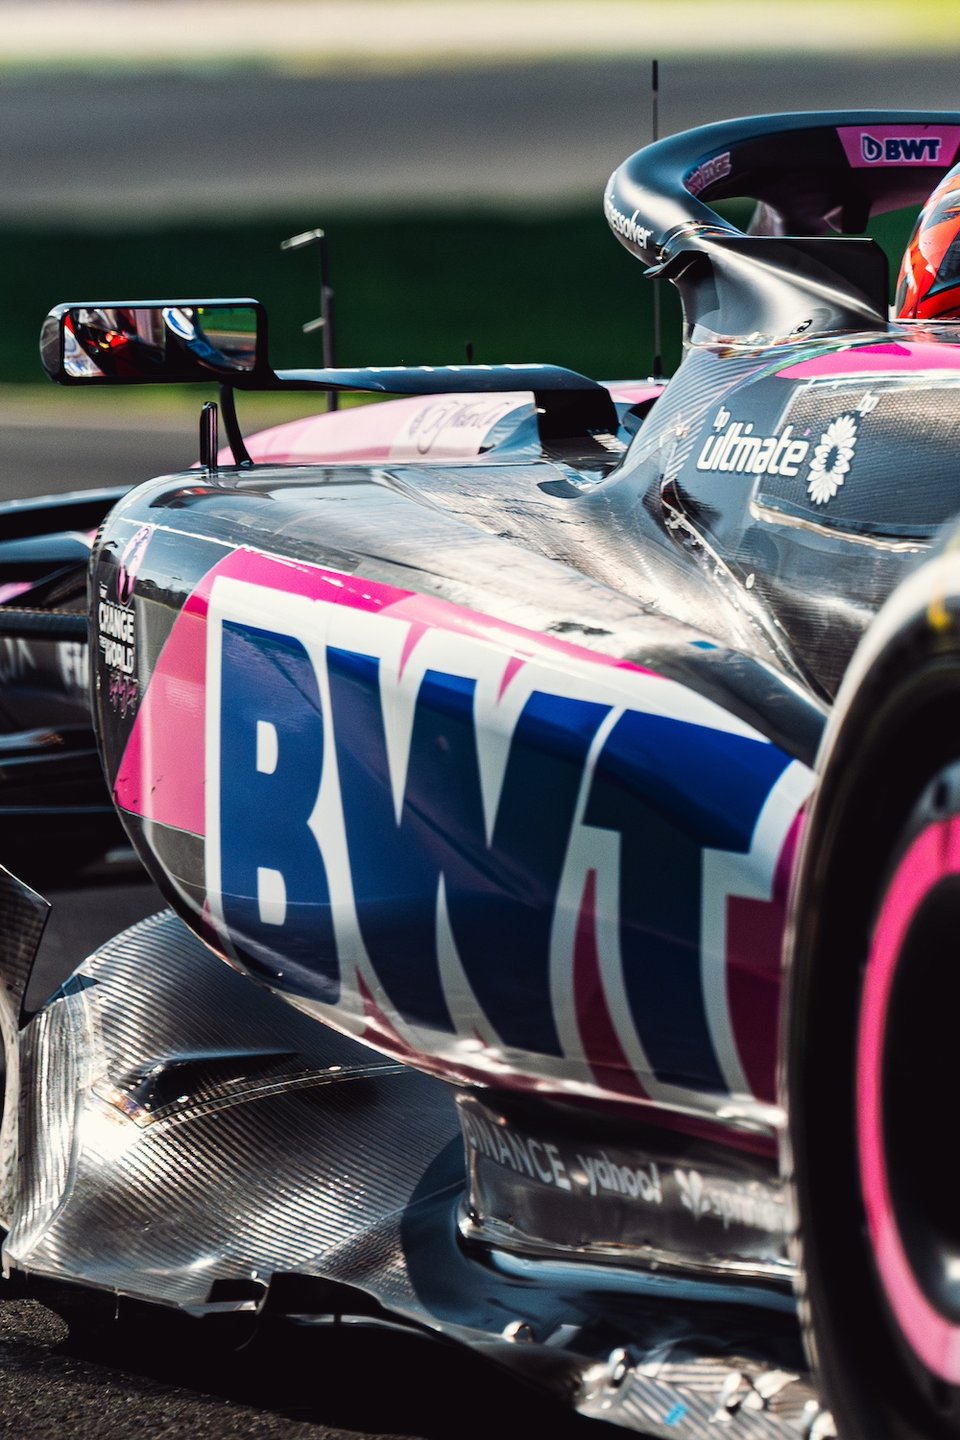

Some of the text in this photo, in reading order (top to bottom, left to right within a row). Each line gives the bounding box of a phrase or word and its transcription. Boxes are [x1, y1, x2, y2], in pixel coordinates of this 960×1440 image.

[885, 138, 941, 162] BWT
[713, 406, 731, 433] bp
[98, 601, 135, 644] CHANGE
[215, 610, 800, 1100] BWT
[577, 1152, 662, 1206] yahoo!
